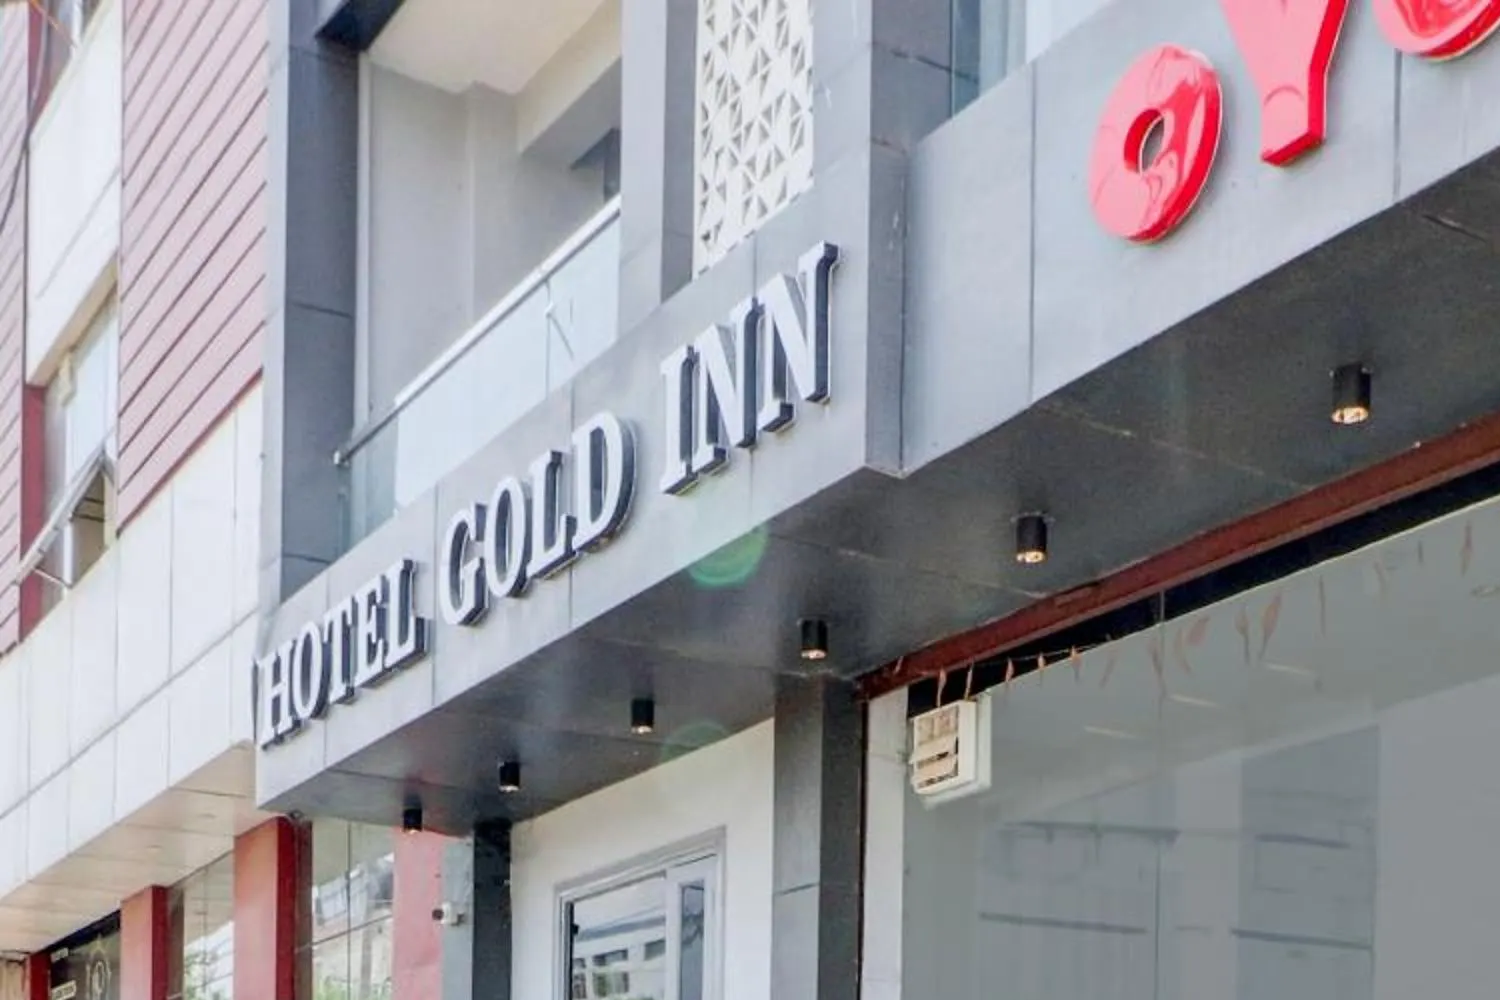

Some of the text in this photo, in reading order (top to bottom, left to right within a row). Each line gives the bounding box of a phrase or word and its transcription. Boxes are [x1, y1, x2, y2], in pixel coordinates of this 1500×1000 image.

[254, 239, 840, 750] HOTEL GOLD INN
